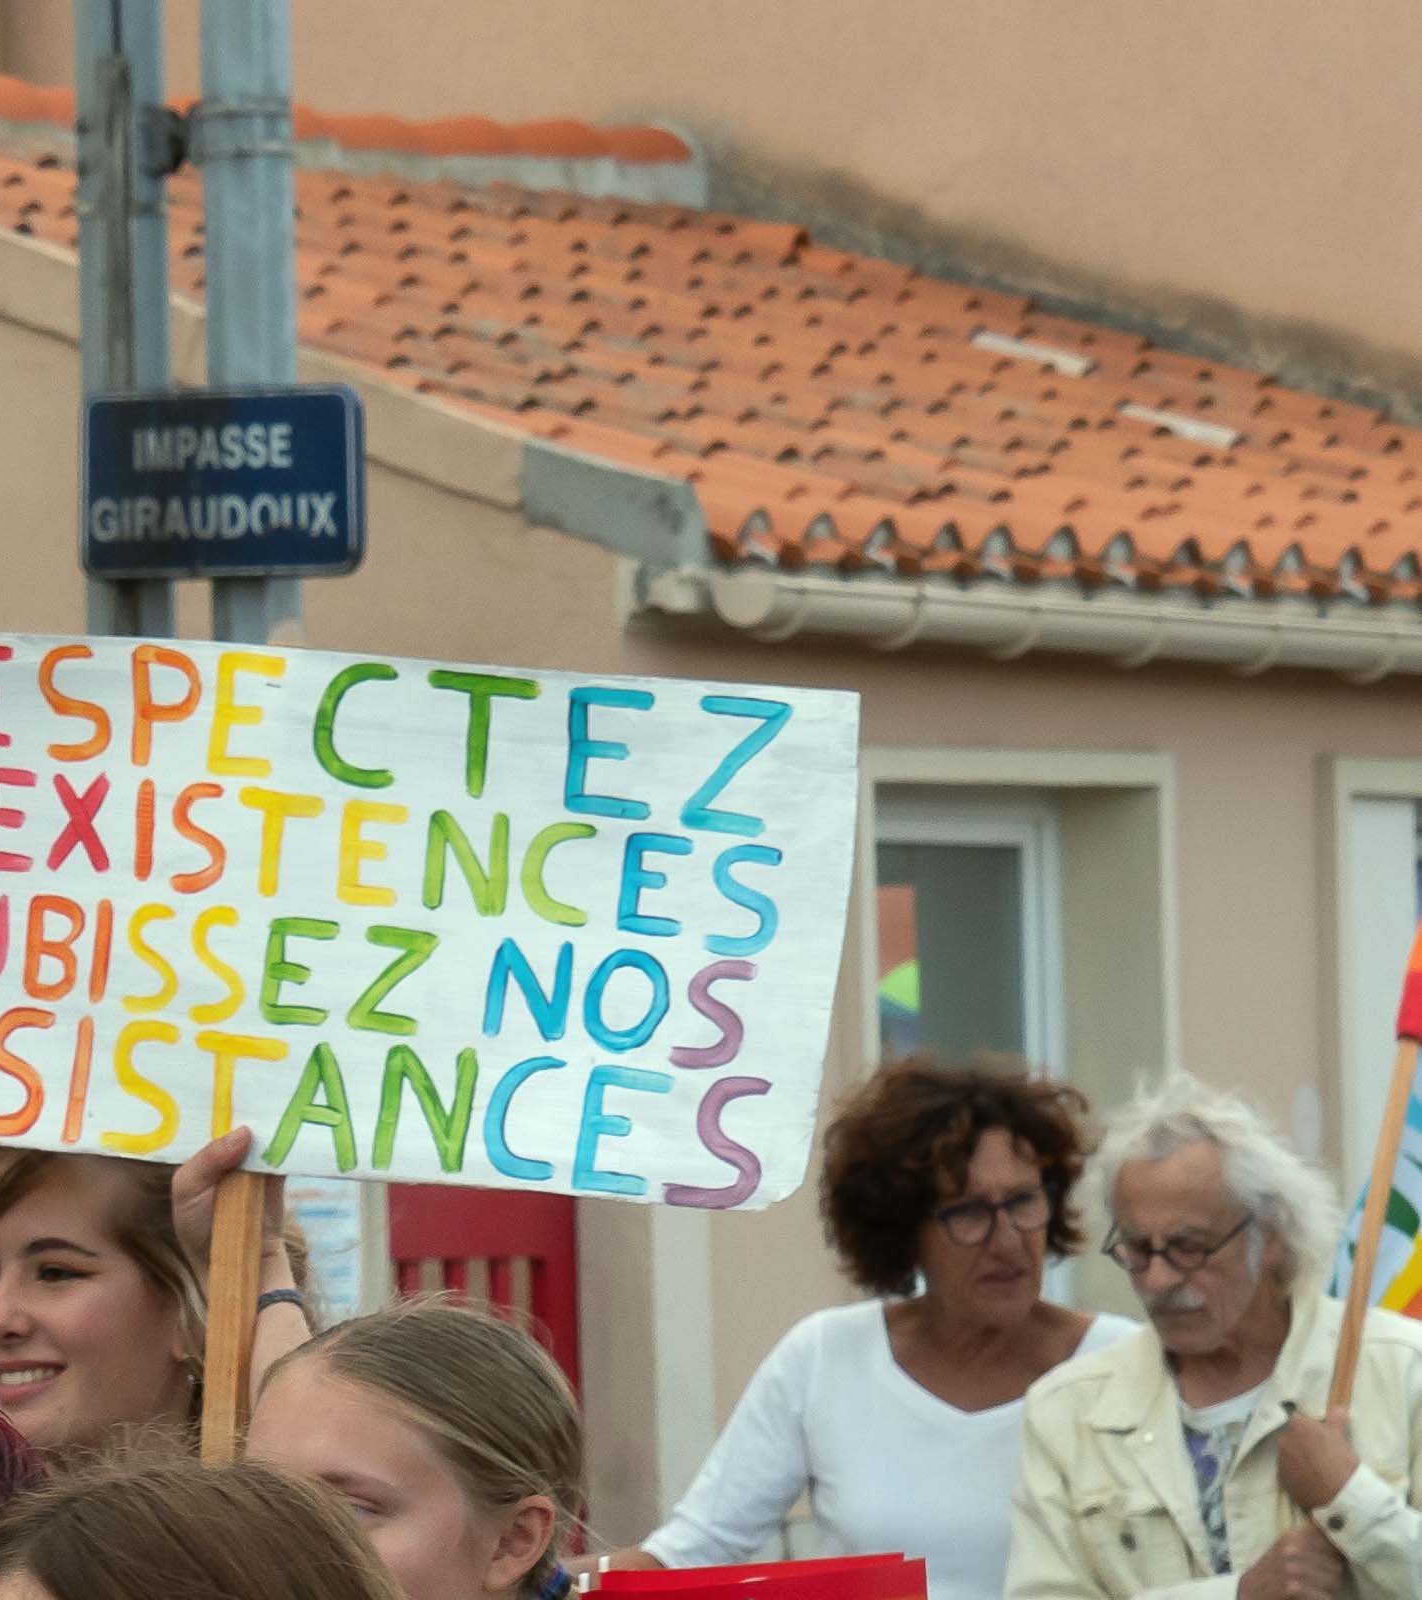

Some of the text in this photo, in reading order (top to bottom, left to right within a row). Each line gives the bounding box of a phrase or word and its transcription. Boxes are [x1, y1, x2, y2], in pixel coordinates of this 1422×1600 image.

[132, 422, 293, 472] IMPASSE
[90, 492, 338, 542] GIRAUDOUX
[482, 936, 759, 1070] NOS
